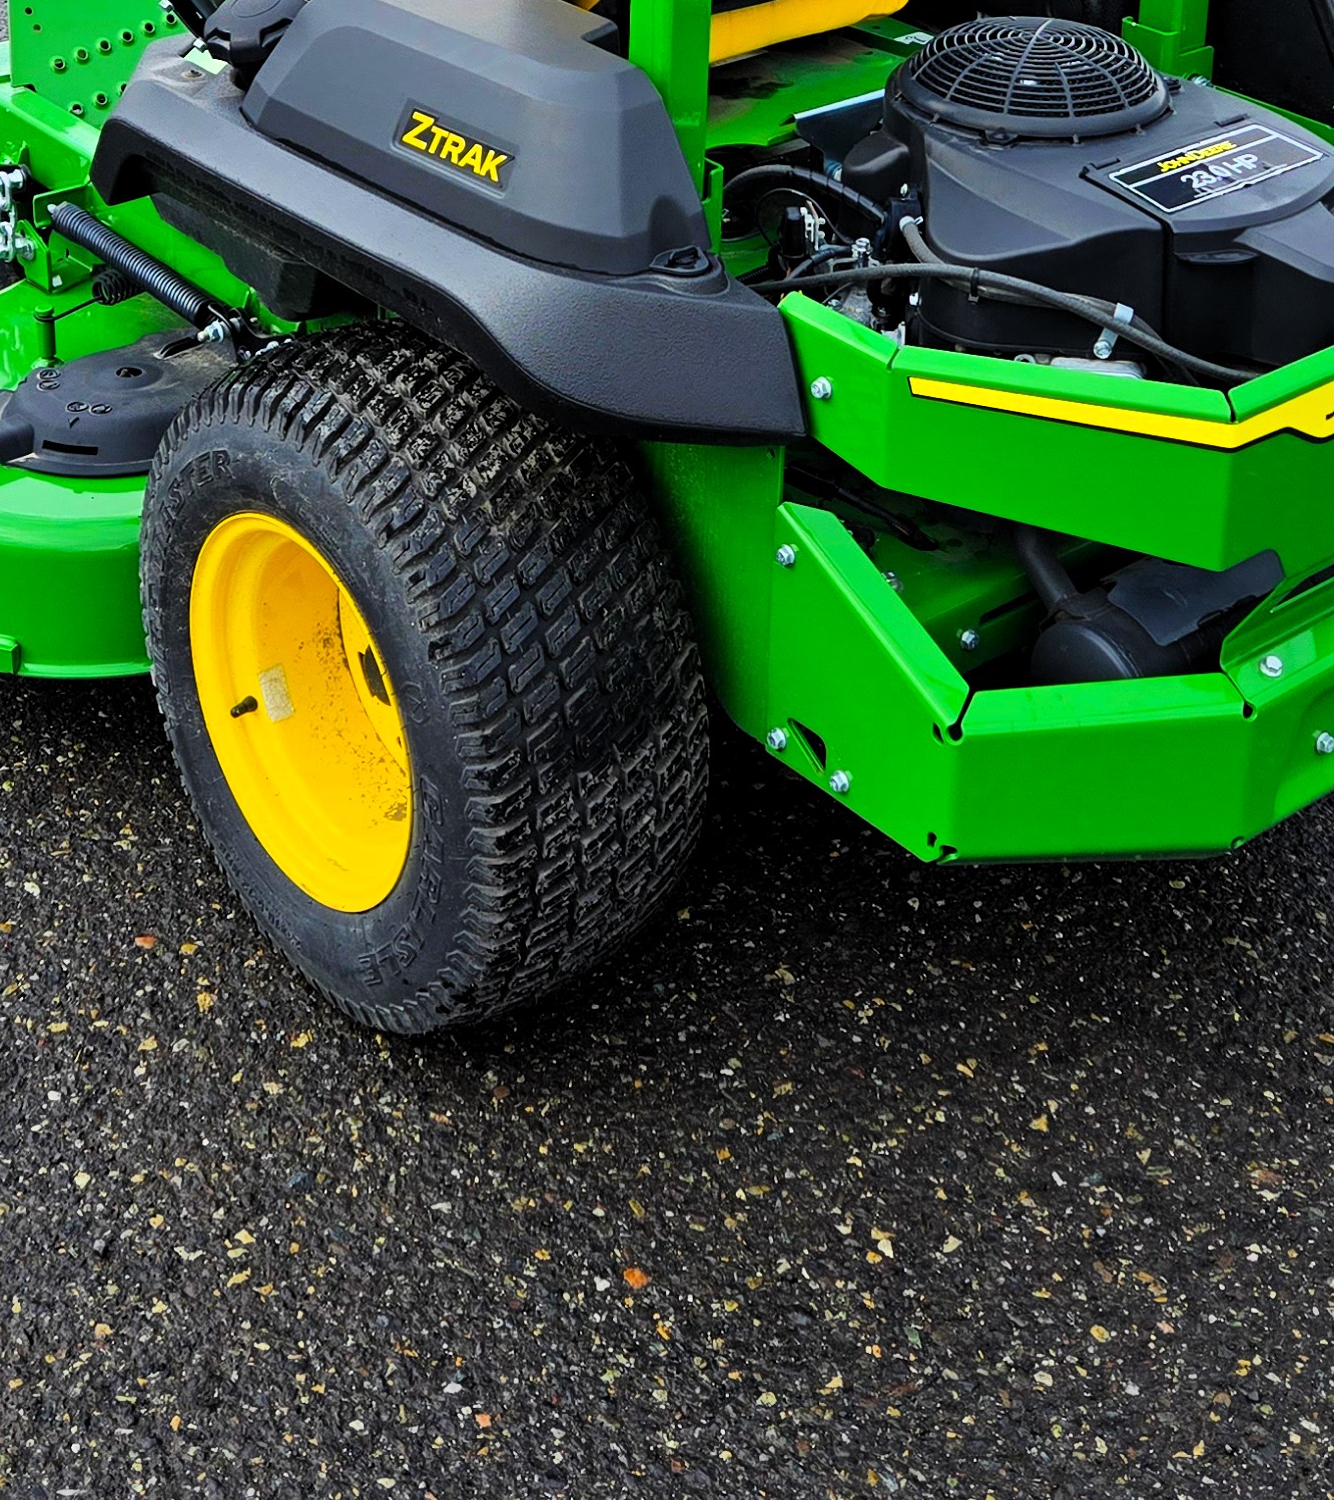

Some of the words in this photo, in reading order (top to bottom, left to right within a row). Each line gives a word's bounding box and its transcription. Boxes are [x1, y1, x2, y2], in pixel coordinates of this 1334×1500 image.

[402, 111, 508, 182] ZTRAK
[1157, 153, 1195, 172] JOHN
[1190, 140, 1237, 161] DEERE
[1224, 153, 1259, 174] HP
